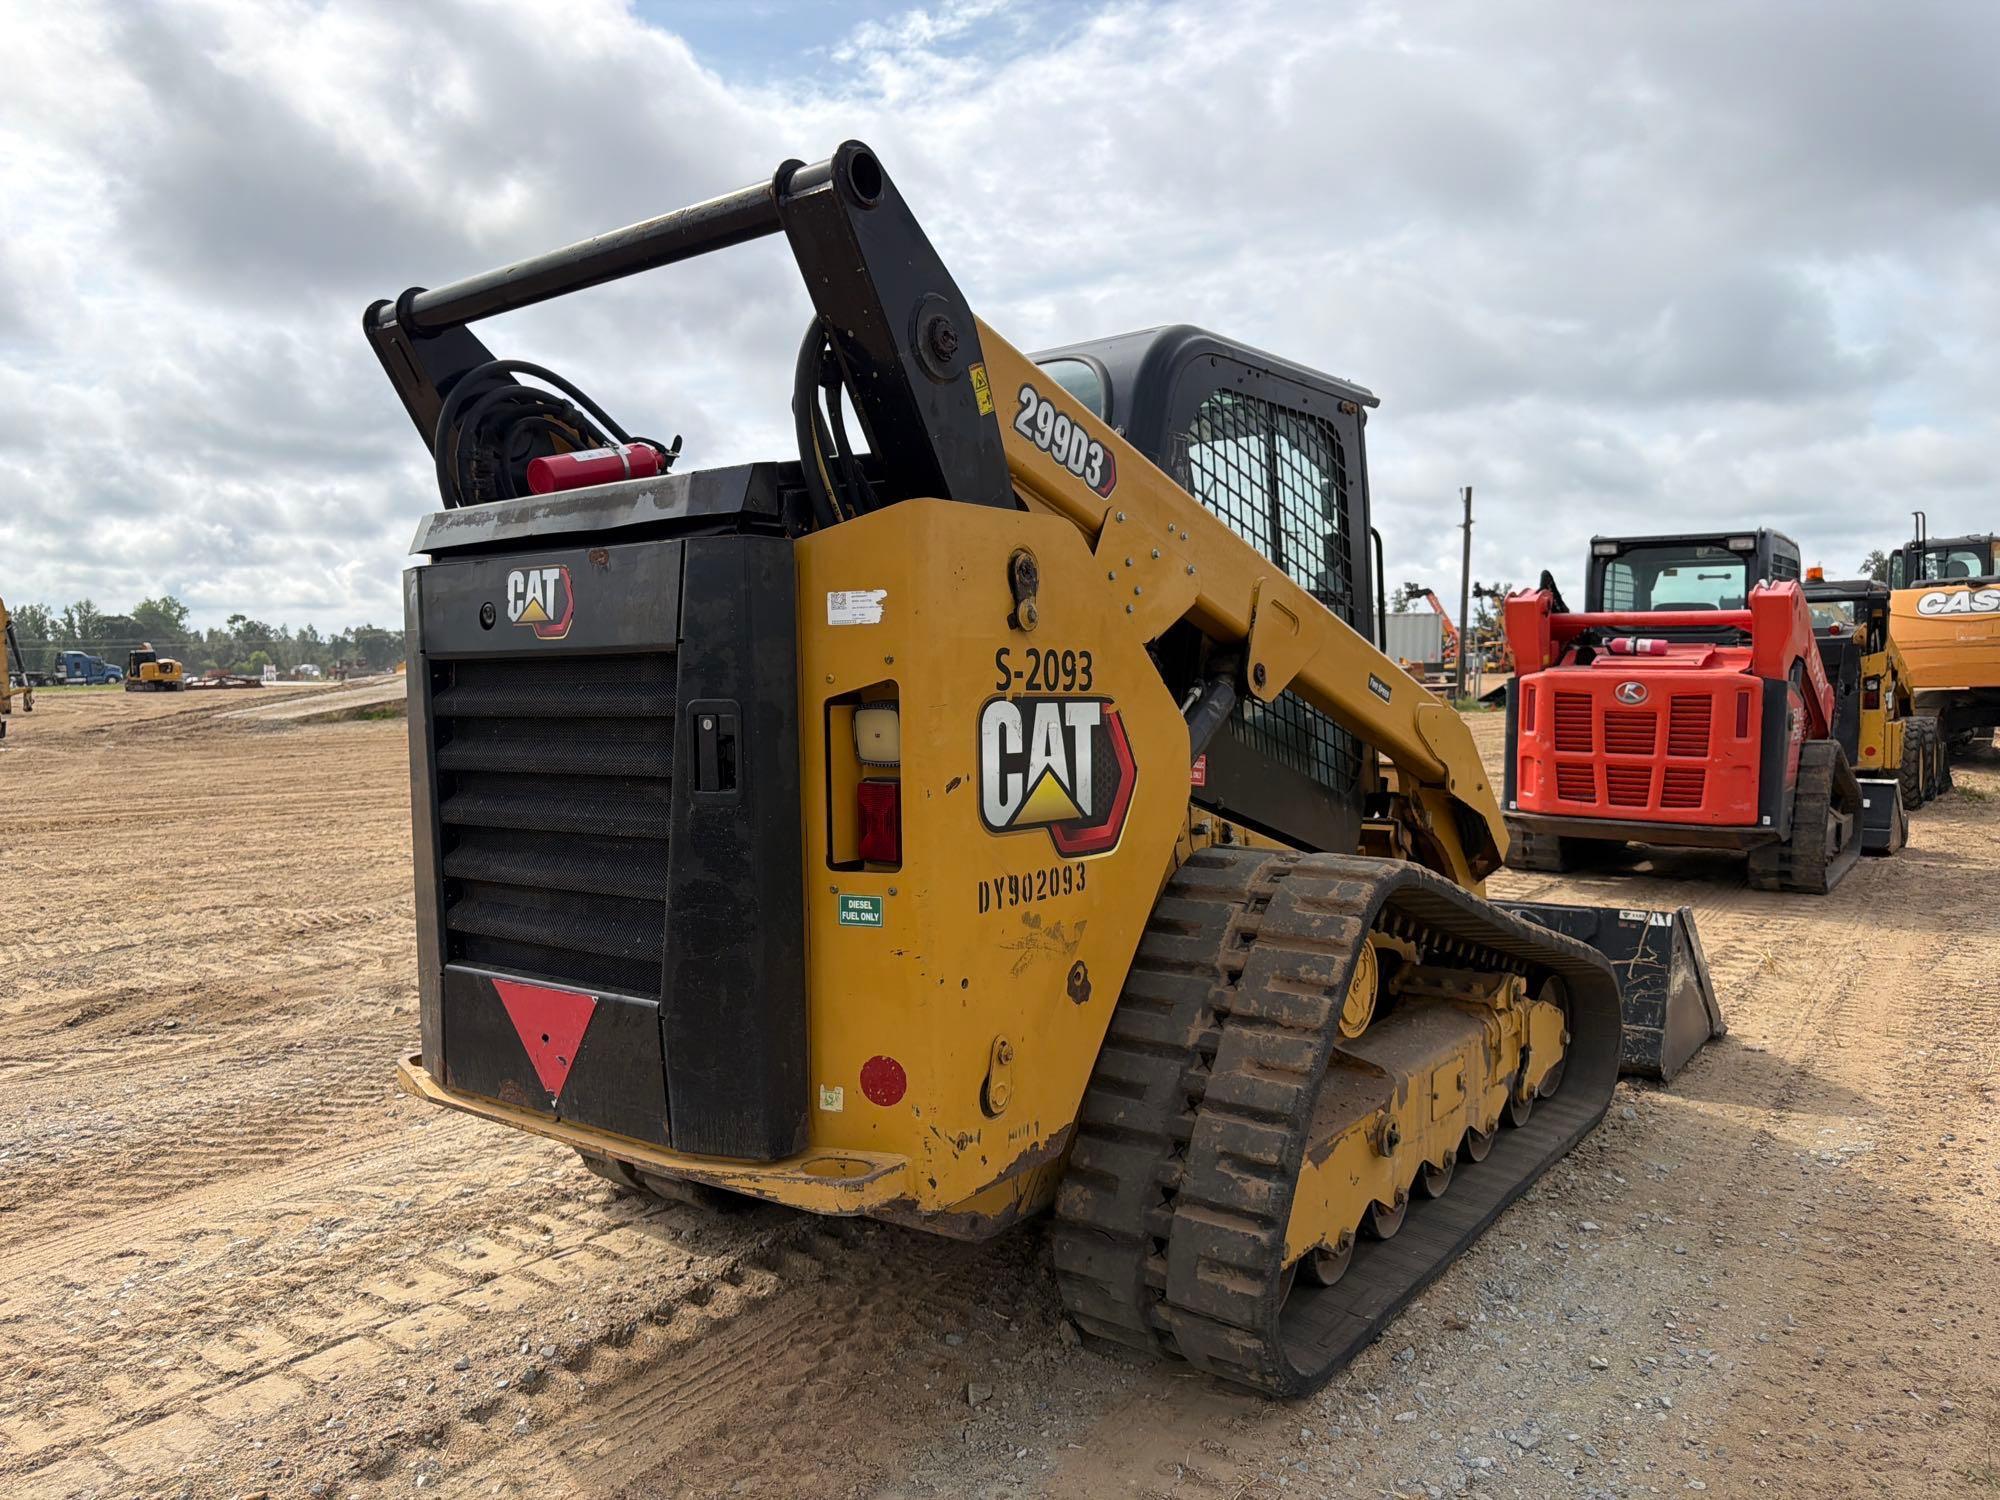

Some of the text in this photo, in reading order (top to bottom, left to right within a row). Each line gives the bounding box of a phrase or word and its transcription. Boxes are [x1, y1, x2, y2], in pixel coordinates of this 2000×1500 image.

[1014, 386, 1104, 488] 299D3
[507, 568, 560, 622] CAT
[1917, 588, 2000, 615] CAS
[995, 647, 1093, 692] S-2093
[981, 700, 1101, 827] CAT
[848, 900, 872, 910] DIESEL
[978, 862, 1086, 914] DY902093
[842, 911, 879, 922] FUEL ONLY
